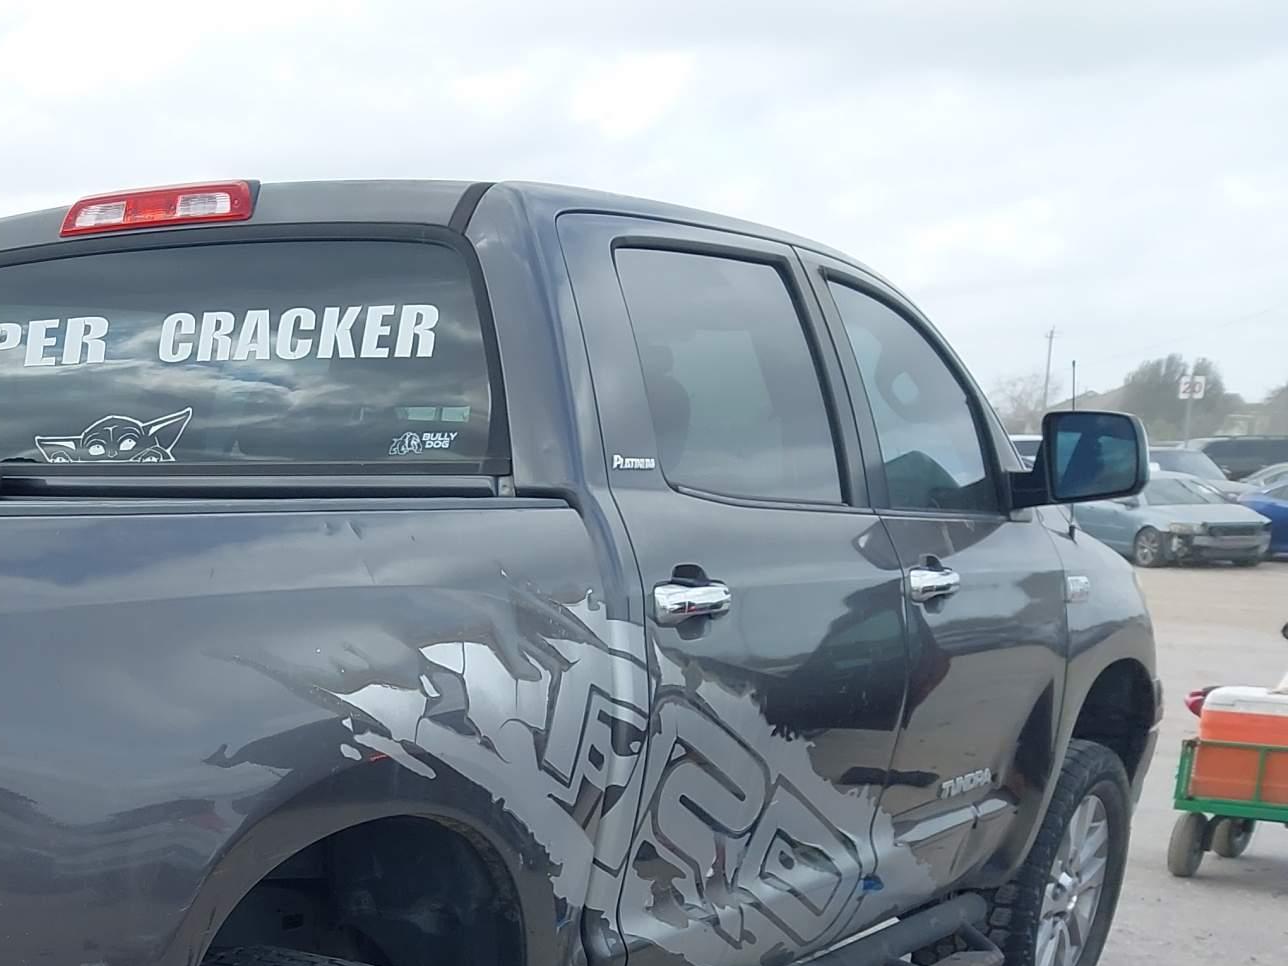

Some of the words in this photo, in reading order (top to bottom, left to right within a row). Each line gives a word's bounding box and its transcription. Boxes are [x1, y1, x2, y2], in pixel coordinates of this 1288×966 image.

[159, 304, 440, 363] CRACKER
[422, 432, 458, 441] BULLY
[425, 440, 450, 448] DOG
